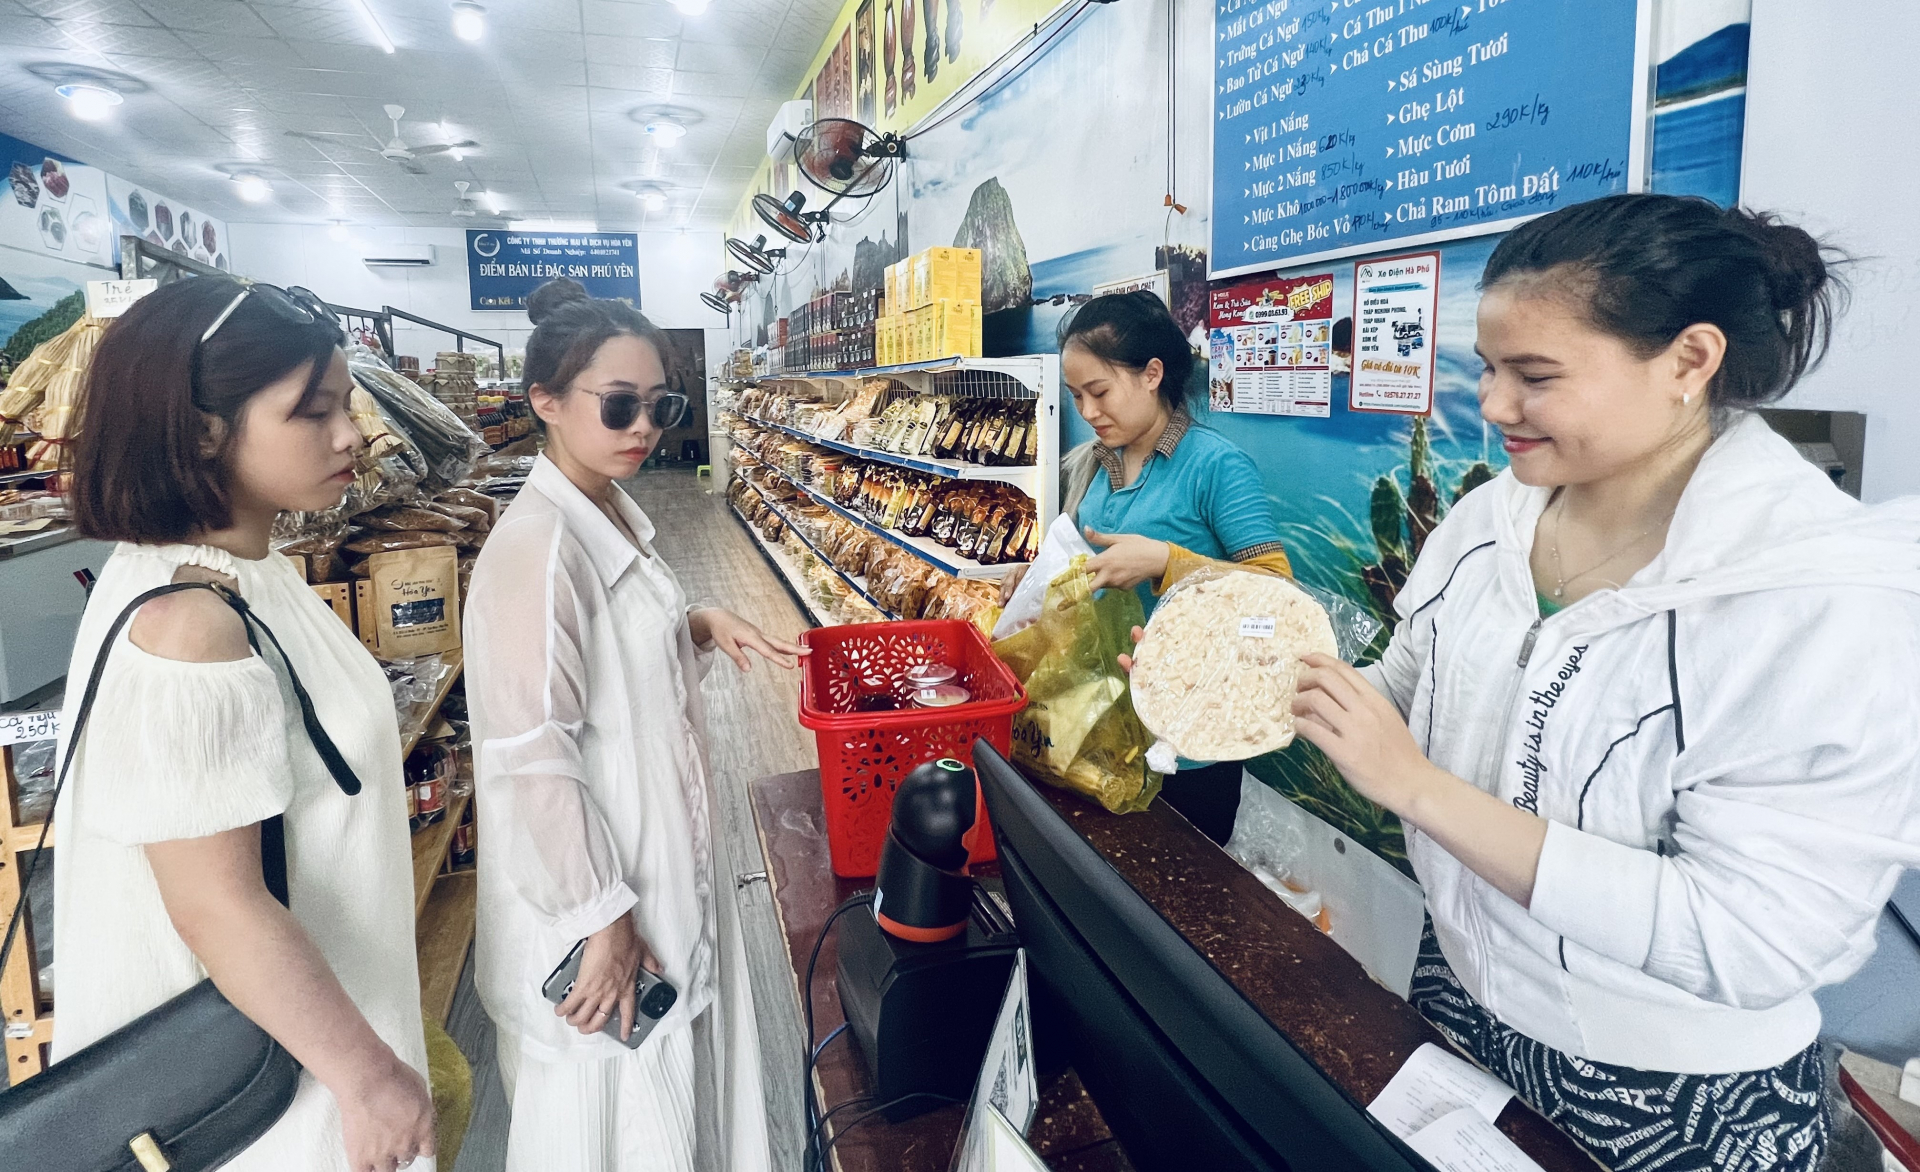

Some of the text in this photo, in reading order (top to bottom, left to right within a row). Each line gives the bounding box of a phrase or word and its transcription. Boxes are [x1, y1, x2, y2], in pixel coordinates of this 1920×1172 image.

[1228, 16, 1246, 40] Mắt
[1250, 8, 1263, 28] Cá
[1260, 30, 1274, 50] Cá
[1277, 18, 1300, 42] Ngừ
[1343, 15, 1361, 39] Cá
[1366, 6, 1393, 29] Thu
[1342, 23, 1428, 70] Chả Cá Thu
[1400, 32, 1508, 92] Sá Sùng Tươi
[1226, 44, 1306, 93] Bao Tử Cá Ngừ
[1226, 78, 1293, 119] Lườn Cá Ngừ
[1399, 87, 1464, 124] Ghẹ Lột
[1254, 111, 1308, 144] Vịt 1 Nắng
[1398, 123, 1476, 158] Mực Cơm
[1252, 137, 1316, 172] Mực 1 Nắng
[1252, 166, 1316, 198] Mực 2 Nắng
[1397, 154, 1470, 190] Hàu Tươi
[1396, 166, 1560, 223] Chả Ram Tôm Đất
[1252, 199, 1300, 226] Mực Khô
[507, 236, 522, 245] CÔNG
[1251, 214, 1350, 252] Càng Ghẹ Bóc Vỏ
[480, 258, 505, 277] ĐIỂM
[508, 261, 528, 277] BÁN
[532, 260, 544, 277] LẺ
[568, 262, 588, 277] SẢN
[592, 262, 612, 278] PHÚ
[614, 262, 634, 278] YÊN
[1389, 268, 1404, 278] Điện
[1406, 266, 1414, 274] Hà
[1417, 264, 1430, 274] Phú
[101, 281, 132, 294] Tré
[1289, 280, 1332, 309] FREE SHIP
[1218, 310, 1246, 320] Hong Kong
[1362, 360, 1420, 378] Giá vé chỉ từ 10K
[1513, 644, 1588, 817] Beauty is in the eyes
